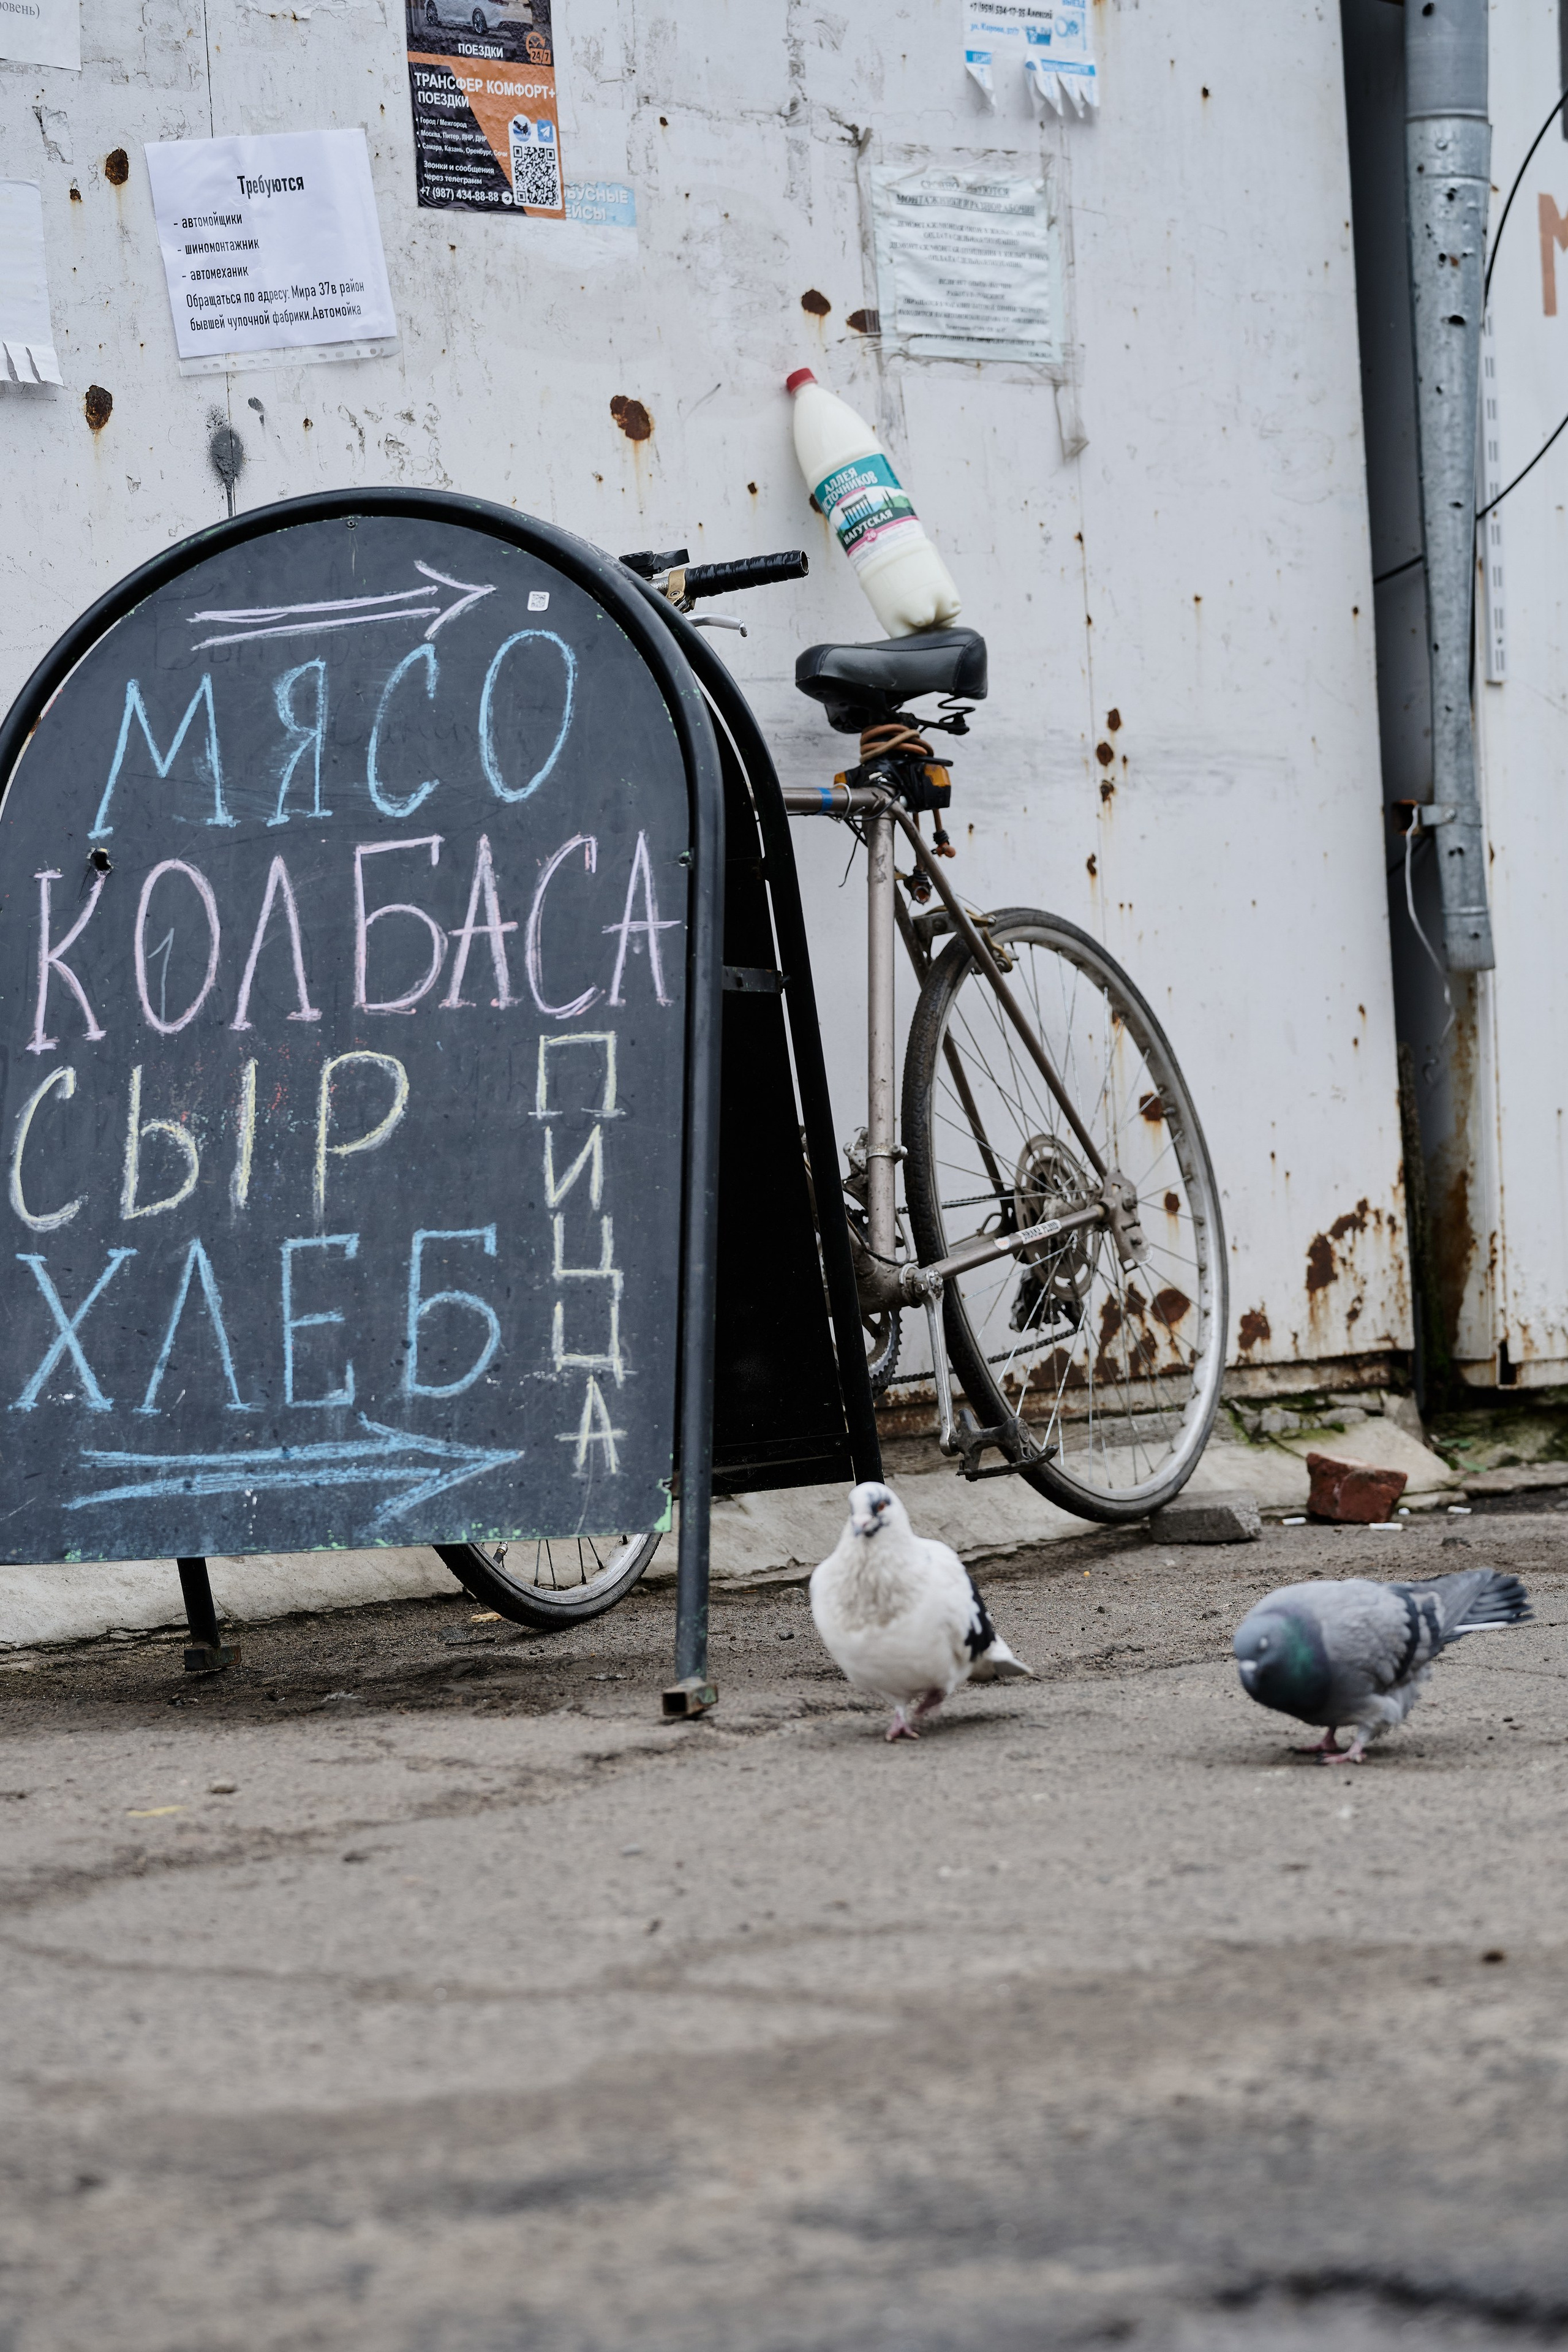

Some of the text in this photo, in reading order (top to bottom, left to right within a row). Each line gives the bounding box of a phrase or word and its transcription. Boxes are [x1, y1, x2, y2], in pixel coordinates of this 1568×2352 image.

[0, 1, 40, 20] овень)
[458, 43, 503, 58] ПОЕЗДКИ
[414, 72, 556, 99] ТРАНСФЕР КОМФОРТ+
[418, 91, 470, 108] ПОЕЗДКИ
[420, 116, 436, 125] Город
[440, 119, 467, 129] Межгород
[421, 129, 442, 138] Москва,
[443, 132, 461, 141] Питер,
[462, 134, 474, 142] ЛНР,
[422, 143, 443, 152] Самара,
[444, 145, 465, 154] Казань,
[466, 147, 492, 157] Оренбург,
[423, 160, 448, 170] Звонки
[455, 164, 494, 175] сообщения
[236, 175, 305, 199] Требуются
[424, 173, 482, 185] через телеграмм
[420, 186, 499, 202] +7 (987) 434-88-88
[181, 211, 243, 228] автомойщики
[185, 239, 260, 255] шиномонтажник
[190, 266, 249, 281] автомеханик
[186, 278, 364, 310] Обращаться по адресу: Мира 37в район
[190, 314, 225, 331] бывшей
[227, 310, 270, 331] чулочной
[824, 467, 858, 494] АЛЛЕЯ
[843, 509, 894, 545] НАГУТСКАЯ
[88, 628, 576, 839] МЯСО
[26, 830, 684, 1053] КОЛБАСА
[9, 1050, 410, 1232] СЫР
[527, 1031, 637, 1477] ПИЦЦА
[7, 1223, 502, 1415] ХЛЕБ
